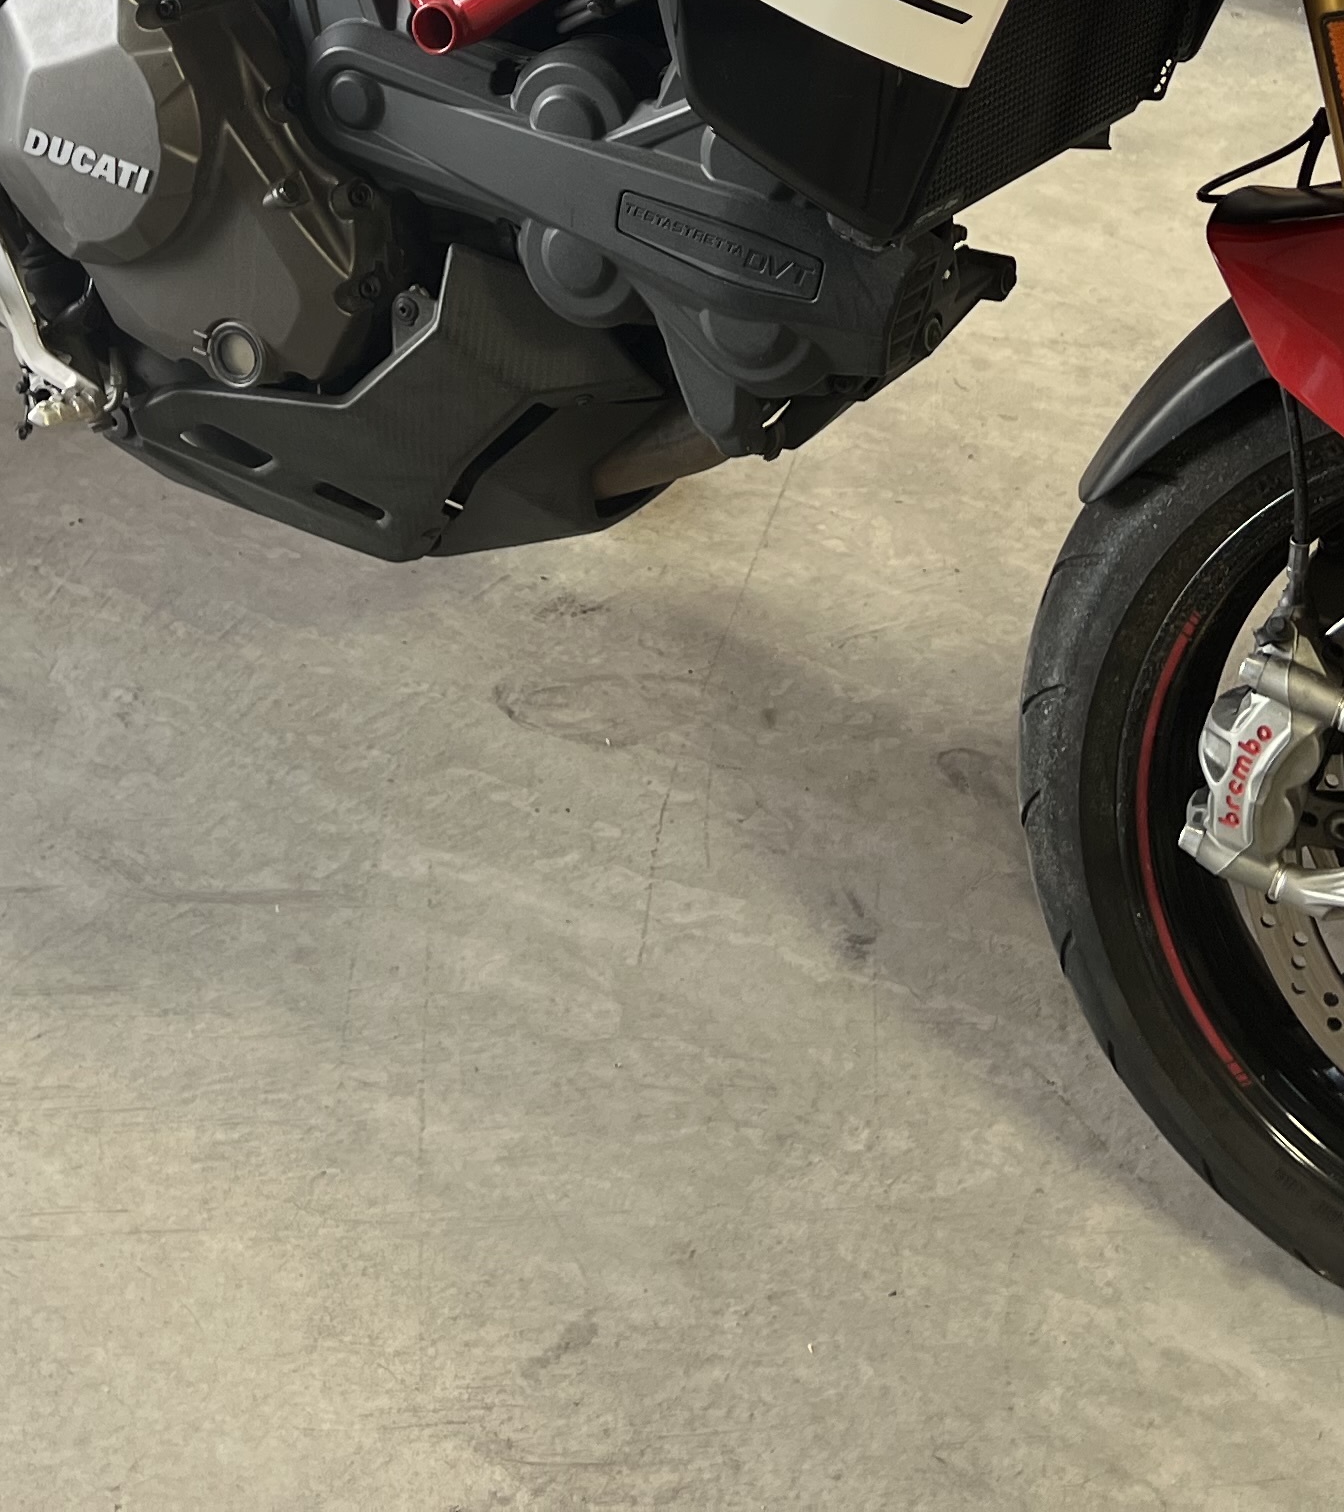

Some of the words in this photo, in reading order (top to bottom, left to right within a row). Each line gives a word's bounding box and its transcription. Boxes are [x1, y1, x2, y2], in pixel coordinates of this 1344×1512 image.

[23, 126, 152, 195] DUCATI
[744, 248, 818, 287] DVT
[1218, 725, 1273, 829] brembo
